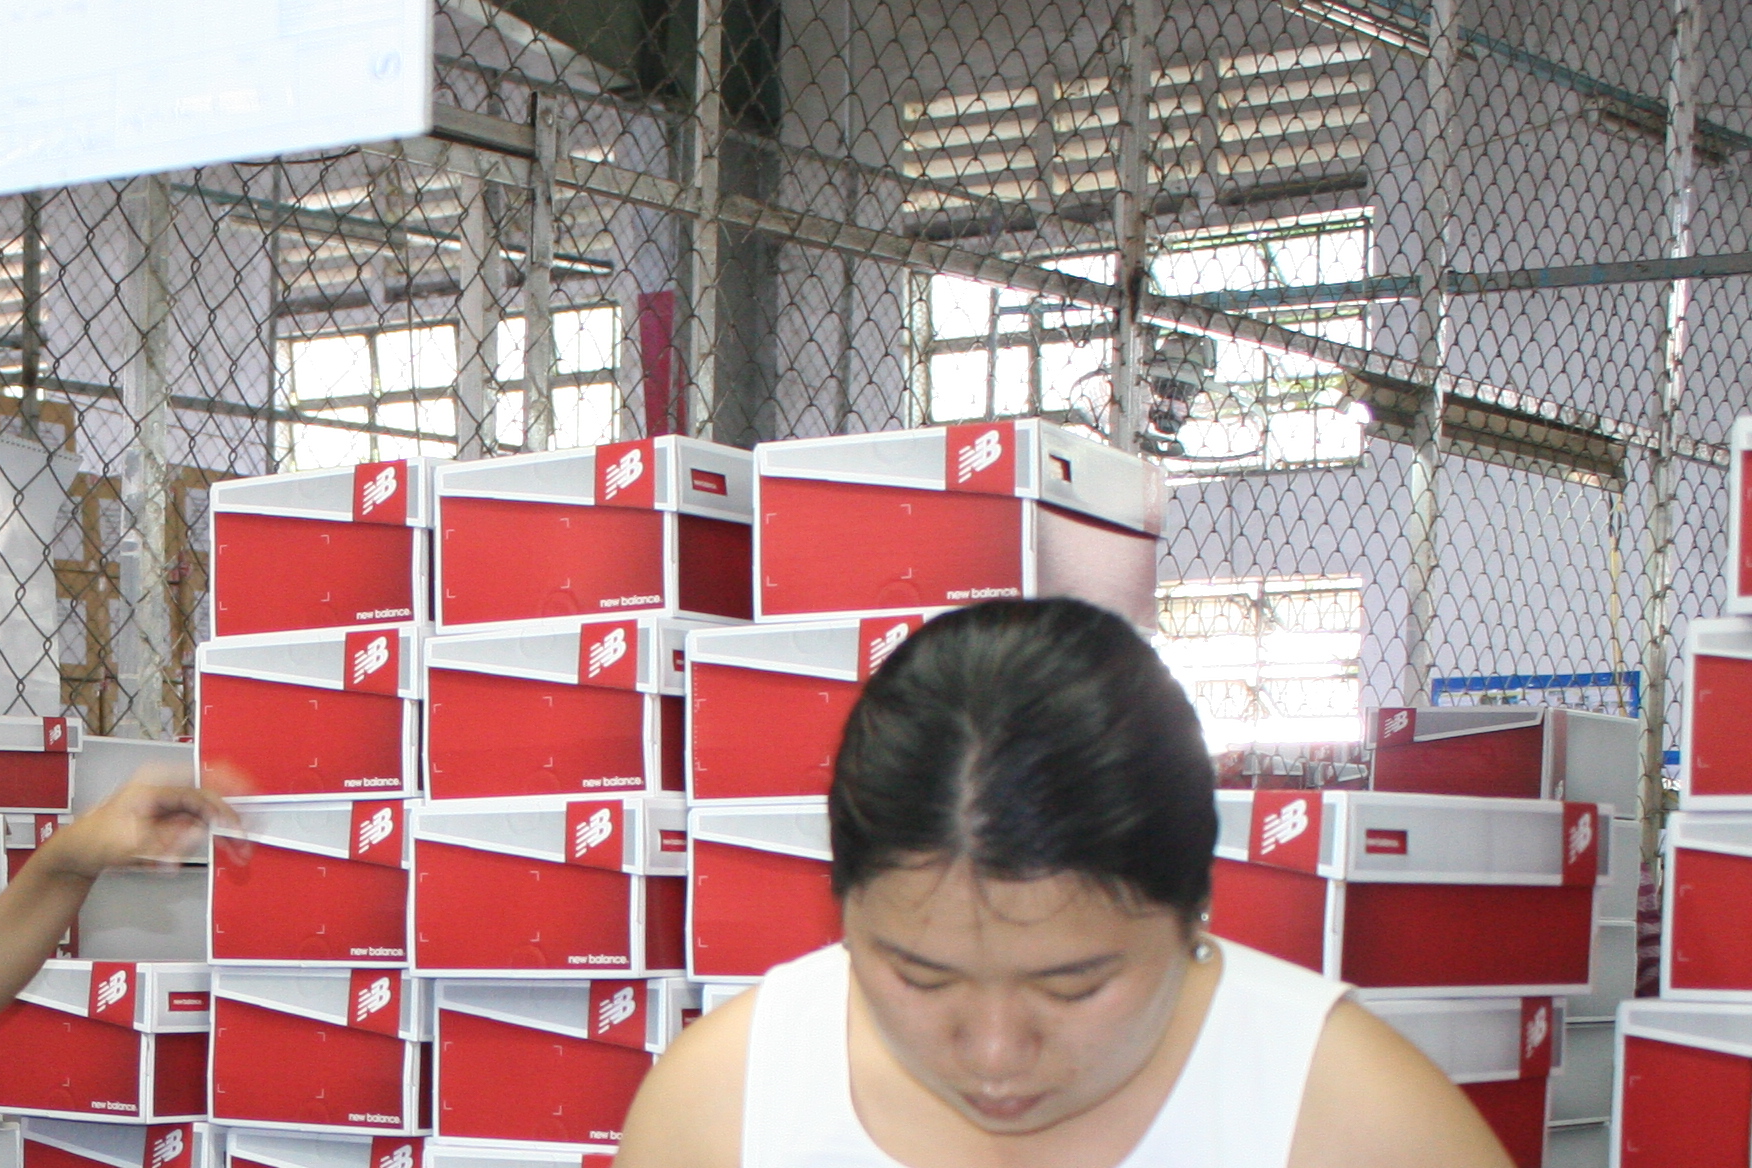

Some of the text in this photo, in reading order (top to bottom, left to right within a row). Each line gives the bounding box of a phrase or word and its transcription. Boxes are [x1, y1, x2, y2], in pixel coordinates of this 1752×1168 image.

[606, 449, 643, 499] NB
[959, 430, 1002, 483] NB
[362, 465, 397, 514] NB
[356, 611, 373, 619] new
[600, 598, 619, 607] new
[947, 590, 969, 600] new
[354, 637, 388, 684] NB
[589, 628, 626, 678] NB
[583, 779, 601, 787] new
[359, 808, 393, 853] NB
[576, 808, 612, 857] NB
[1261, 799, 1308, 854] NB
[568, 956, 586, 964] new
[97, 970, 127, 1012] NB
[357, 977, 391, 1021] NB
[598, 987, 636, 1034] NB
[91, 1101, 106, 1109] new
[152, 1129, 183, 1168] NB
[590, 1130, 608, 1139] new
